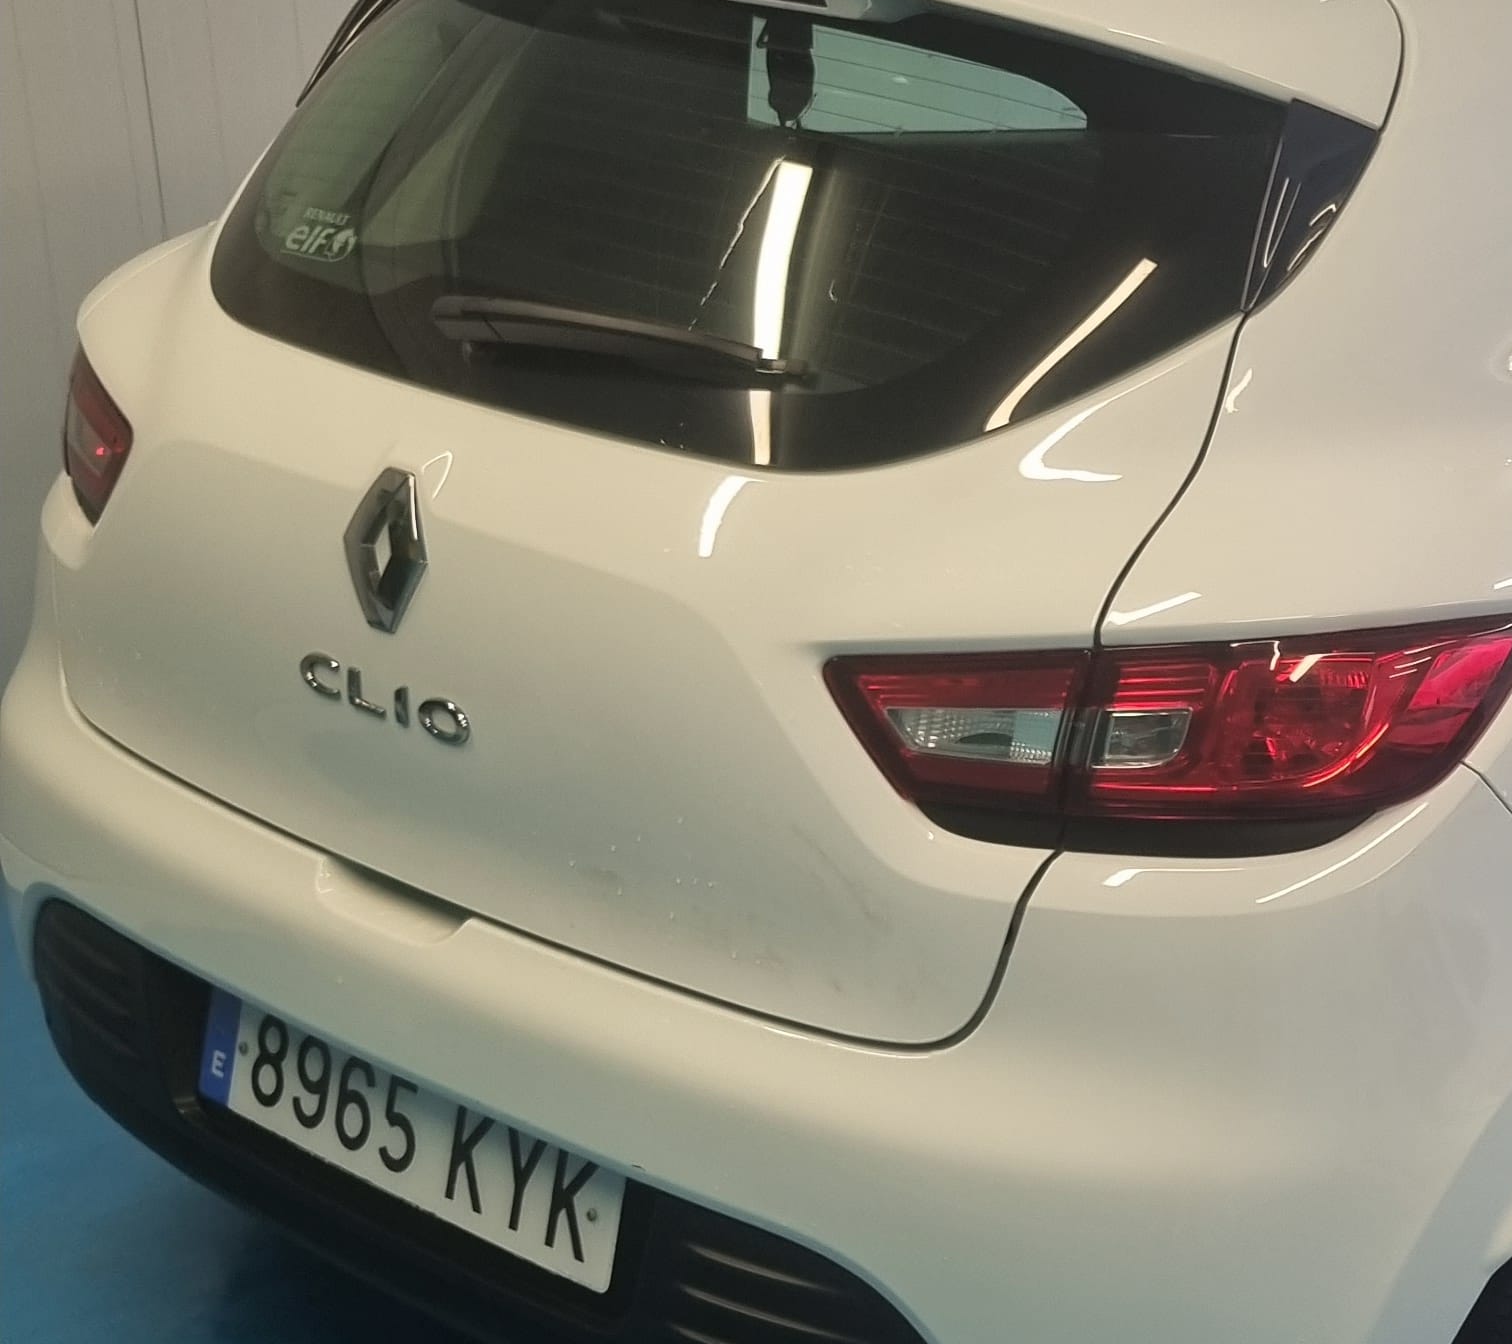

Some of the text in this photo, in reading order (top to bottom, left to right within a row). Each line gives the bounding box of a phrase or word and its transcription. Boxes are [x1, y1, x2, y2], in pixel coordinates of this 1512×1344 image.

[286, 225, 336, 254] elf
[300, 652, 471, 746] CLIO
[251, 1014, 599, 1263] 8965 KYK
